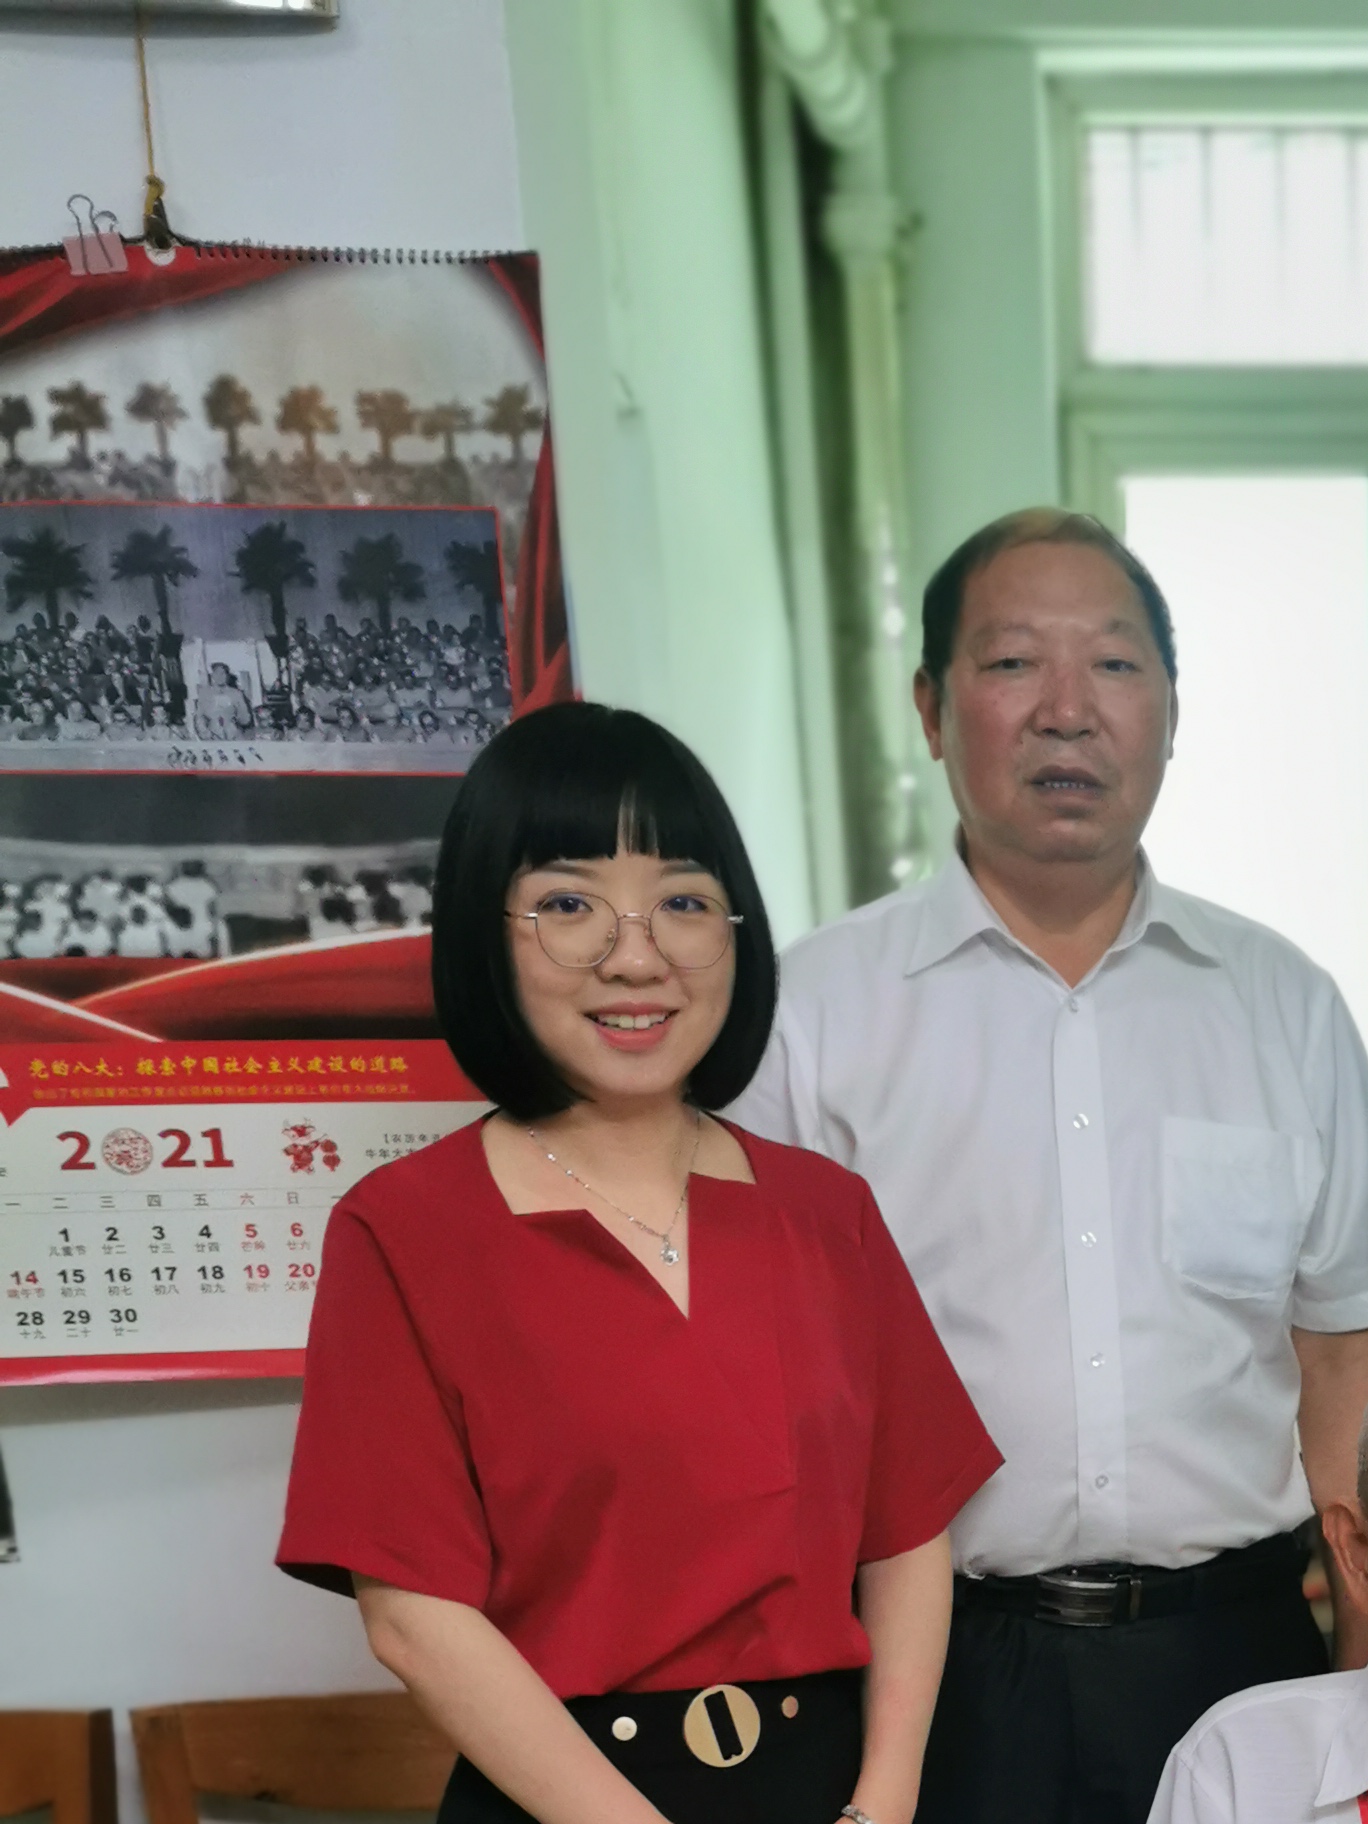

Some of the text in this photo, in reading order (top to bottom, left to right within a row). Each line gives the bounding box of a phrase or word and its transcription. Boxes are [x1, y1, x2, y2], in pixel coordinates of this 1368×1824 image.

[53, 1197, 68, 1209] 二
[100, 1195, 115, 1209] 三
[147, 1194, 162, 1207] 四
[194, 1193, 209, 1206] 五
[240, 1192, 255, 1206] 六
[286, 1191, 299, 1205] 日
[58, 1222, 304, 1243] 1 2 3 4 5 6
[10, 1263, 316, 1286] 14 15 16 17 18 19 20
[16, 1308, 138, 1327] 28 29 30
